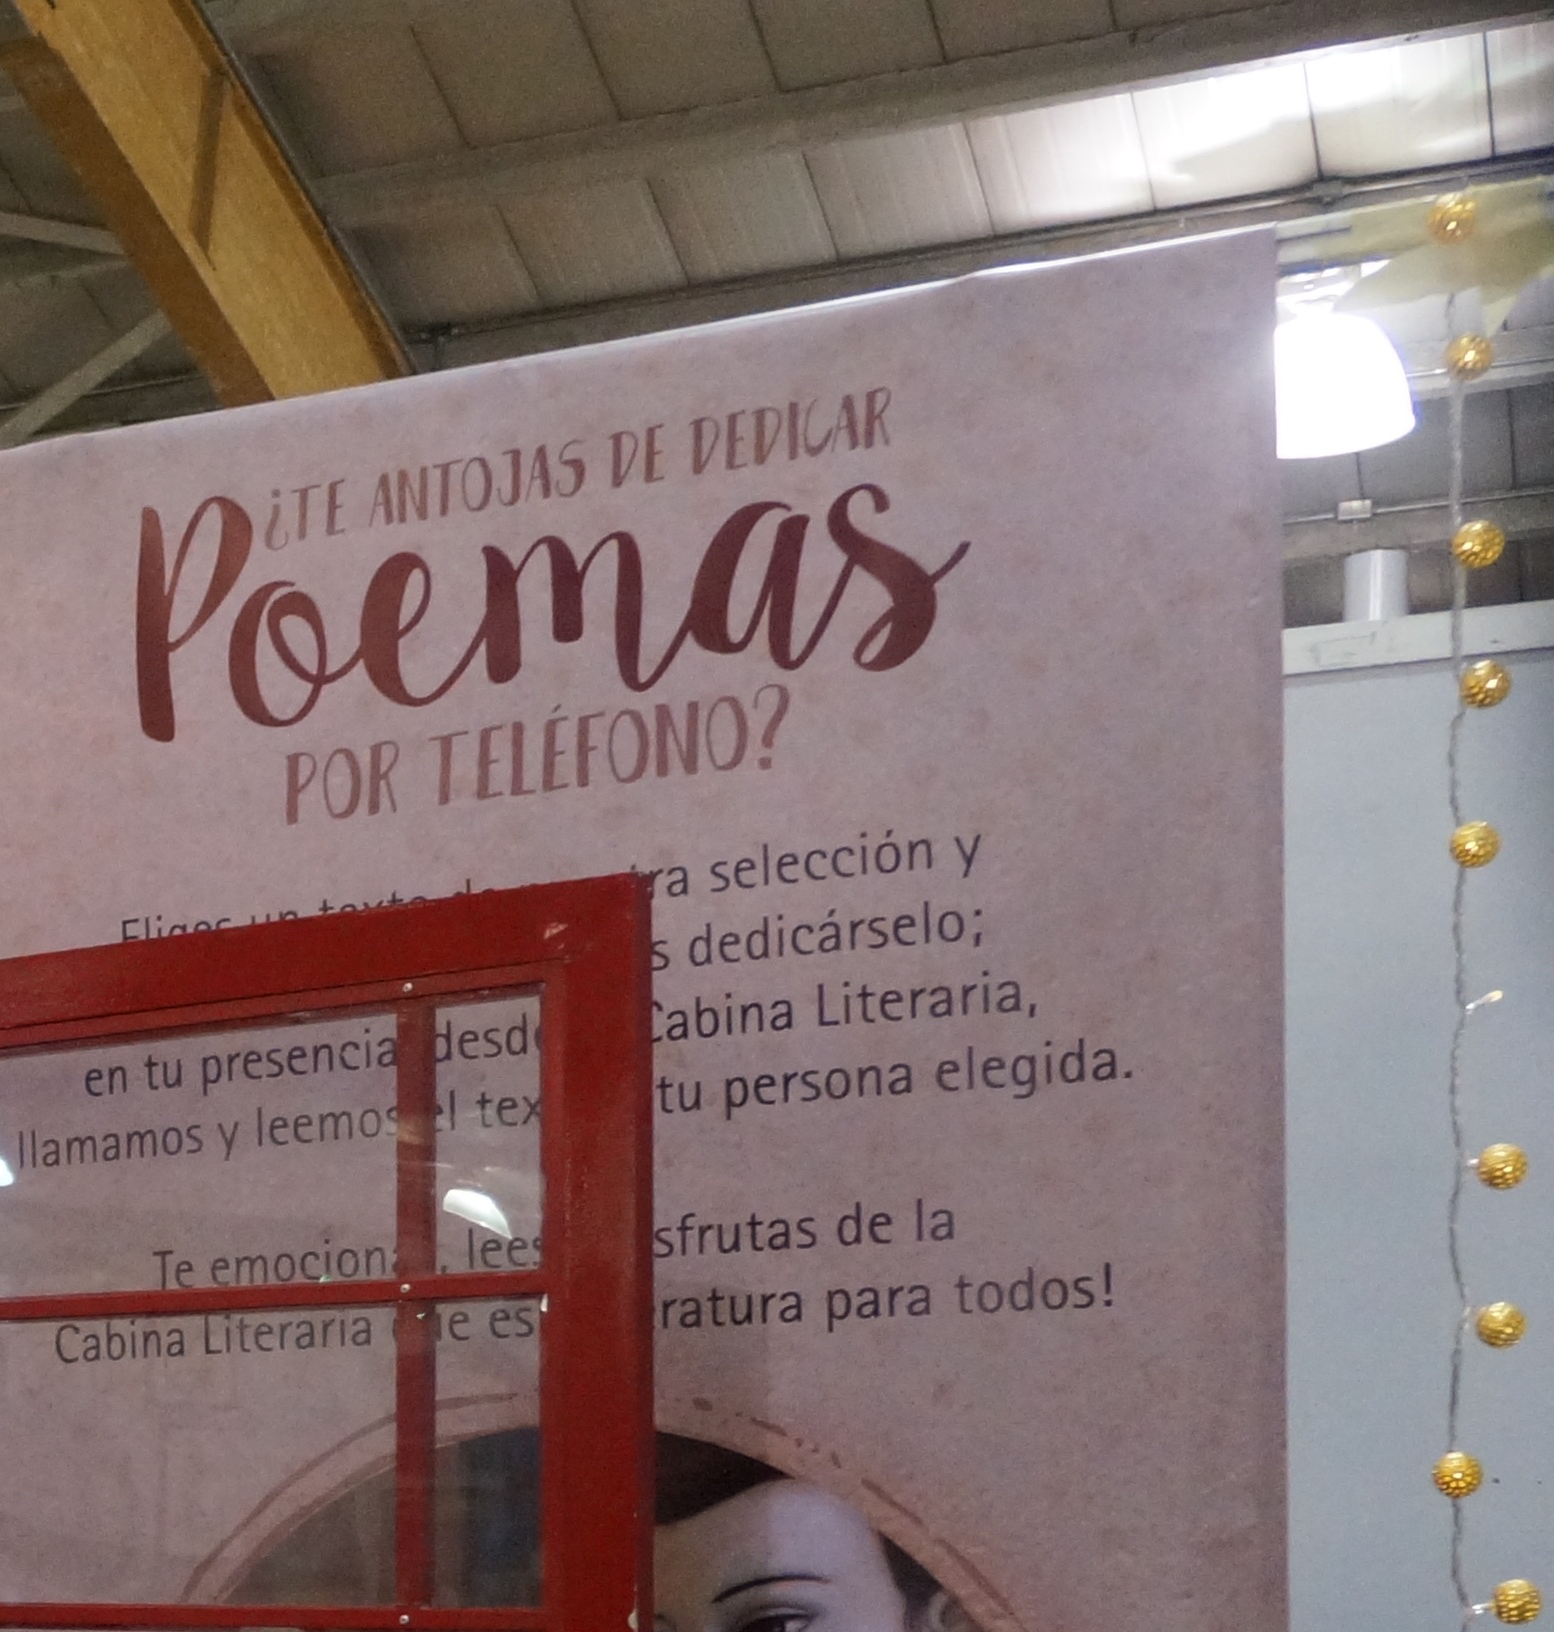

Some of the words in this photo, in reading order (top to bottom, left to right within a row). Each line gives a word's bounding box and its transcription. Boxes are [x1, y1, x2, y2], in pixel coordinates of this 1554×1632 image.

[264, 476, 347, 552] ¿TE
[367, 438, 586, 530] ANTOJAS
[609, 422, 666, 490] DE
[689, 385, 893, 476] DEDICAR
[135, 481, 973, 743] Poemas
[285, 739, 398, 825] POR
[427, 682, 793, 808] TELÉFONO?
[709, 828, 934, 893] selección
[954, 833, 983, 878] y
[687, 900, 985, 968] dedicárselo;
[815, 970, 1039, 1028] Literaria,
[84, 1062, 128, 1098] en
[144, 1053, 183, 1092] tu
[434, 1013, 542, 1064] desd
[657, 1071, 703, 1116] tu
[723, 1055, 914, 1120] persona
[934, 1037, 1135, 1100] elegida.
[17, 1120, 204, 1170] llamamos
[217, 1119, 240, 1162] y
[255, 1105, 397, 1149] leemos
[474, 1092, 542, 1129] tex
[652, 1211, 818, 1260] sfrutas
[836, 1200, 894, 1247] de
[915, 1197, 956, 1243] la
[152, 1249, 194, 1291] Te
[660, 1286, 804, 1330] ratura
[826, 1283, 933, 1334] para
[953, 1261, 1116, 1316] todos!
[54, 1319, 186, 1366] Cabina
[203, 1312, 373, 1357] Literaria
